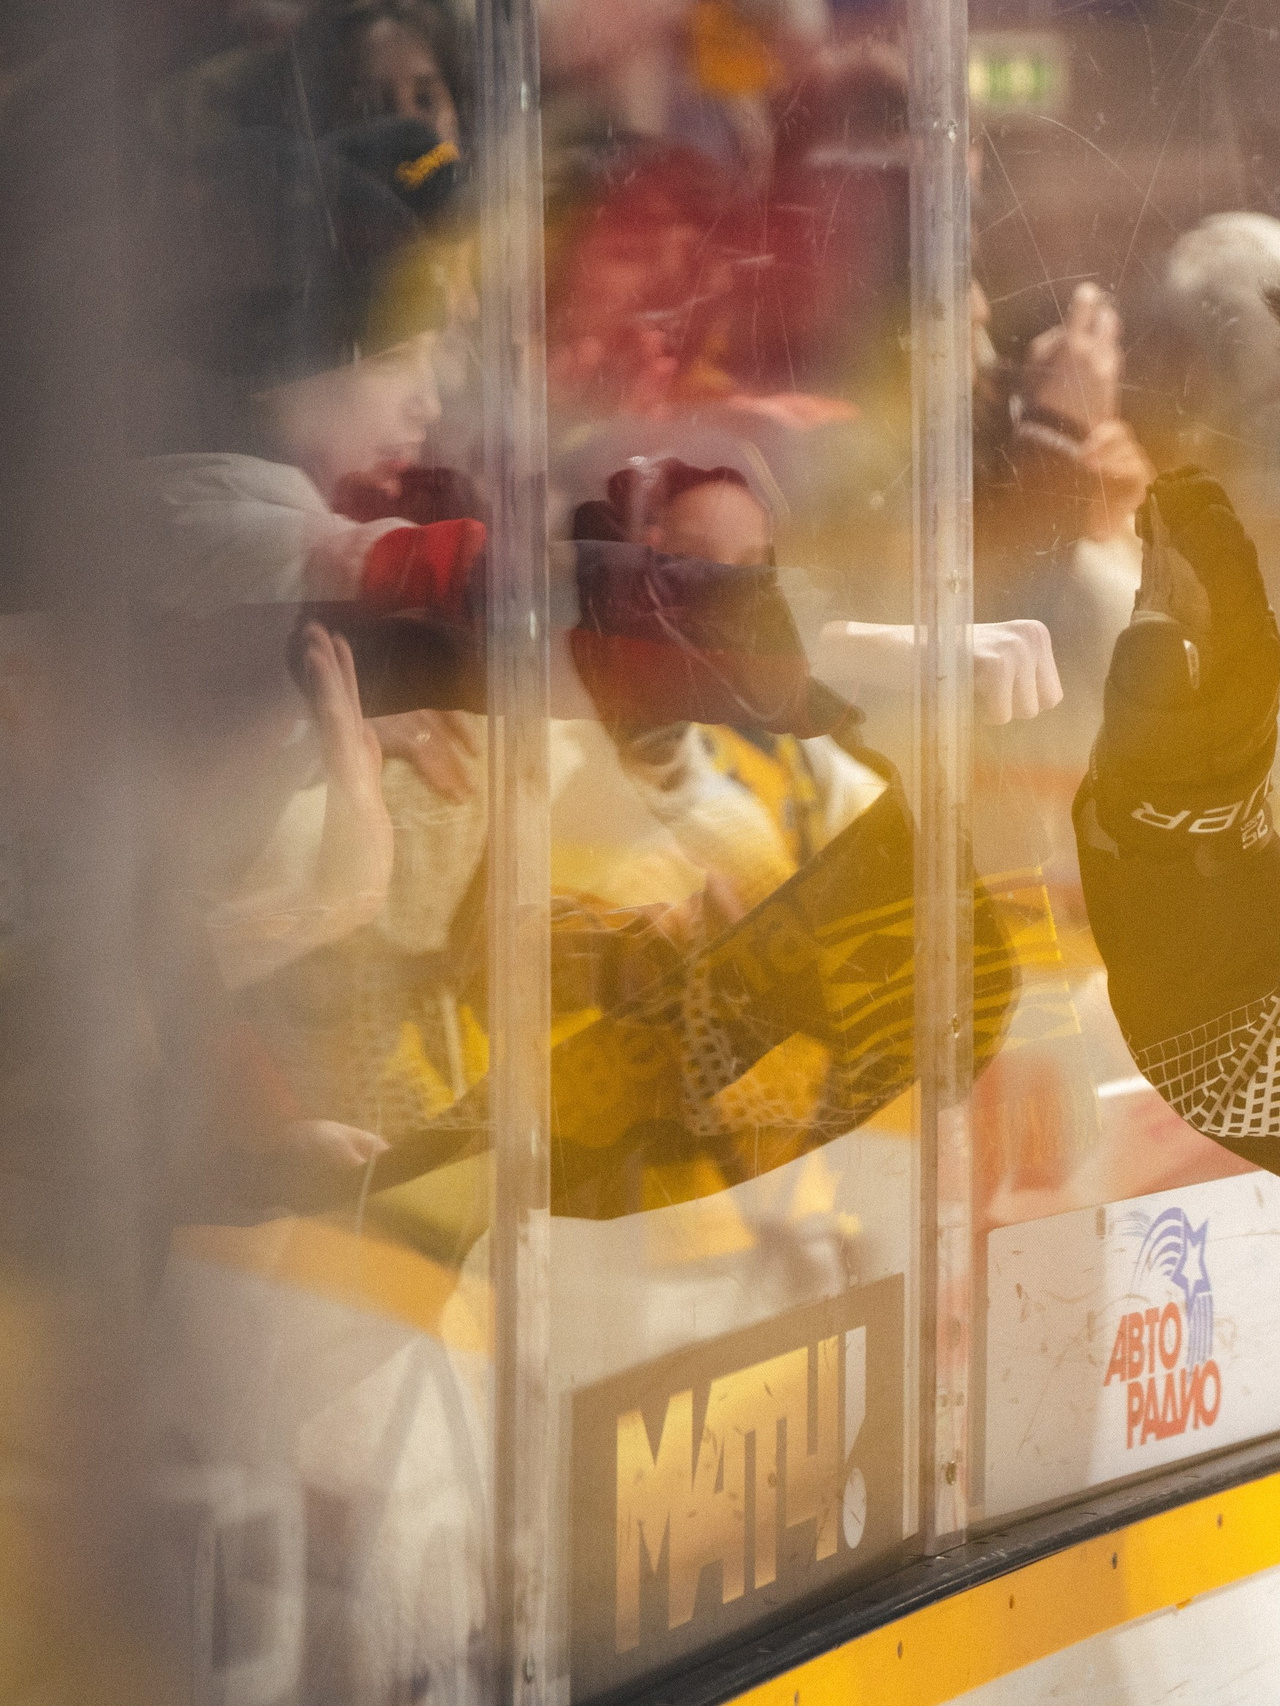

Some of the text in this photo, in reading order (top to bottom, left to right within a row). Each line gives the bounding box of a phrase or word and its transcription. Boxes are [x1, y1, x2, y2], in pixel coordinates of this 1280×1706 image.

[1103, 1301, 1183, 1388] АВТО
[1126, 1358, 1222, 1450] РАДИО
[614, 1324, 868, 1656] МАТЧ!
